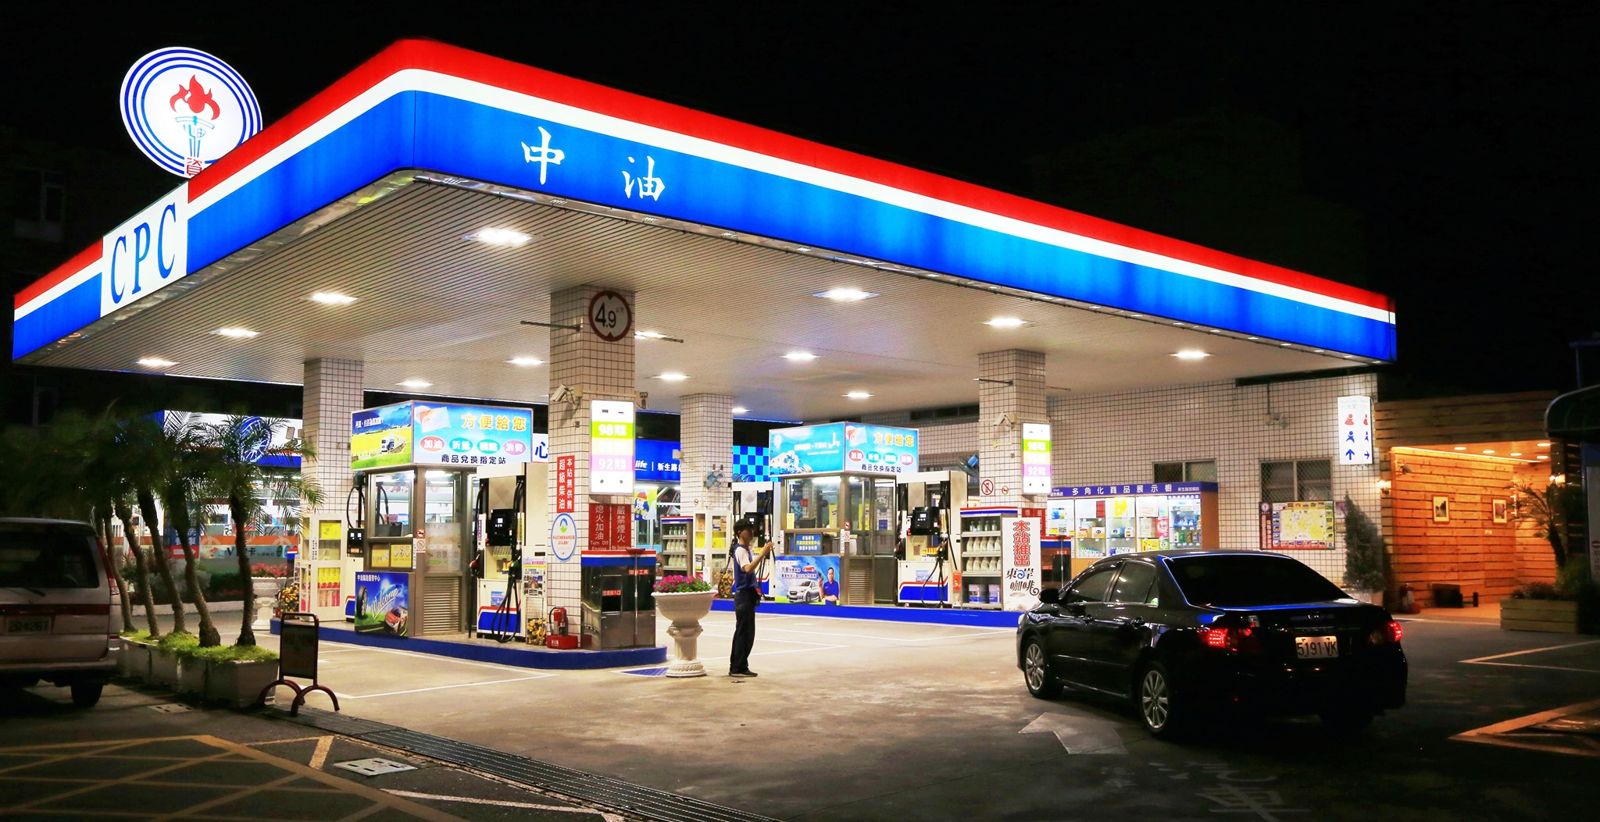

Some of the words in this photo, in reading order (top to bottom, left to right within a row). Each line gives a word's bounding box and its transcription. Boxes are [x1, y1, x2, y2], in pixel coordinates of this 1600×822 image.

[110, 202, 176, 304] CPC
[595, 302, 616, 329] 4.9
[461, 413, 527, 432] 方便給您
[441, 454, 506, 465] 商品兌換指定站
[617, 505, 626, 544] 嚴禁煙火
[1013, 520, 1031, 567] 本站推出
